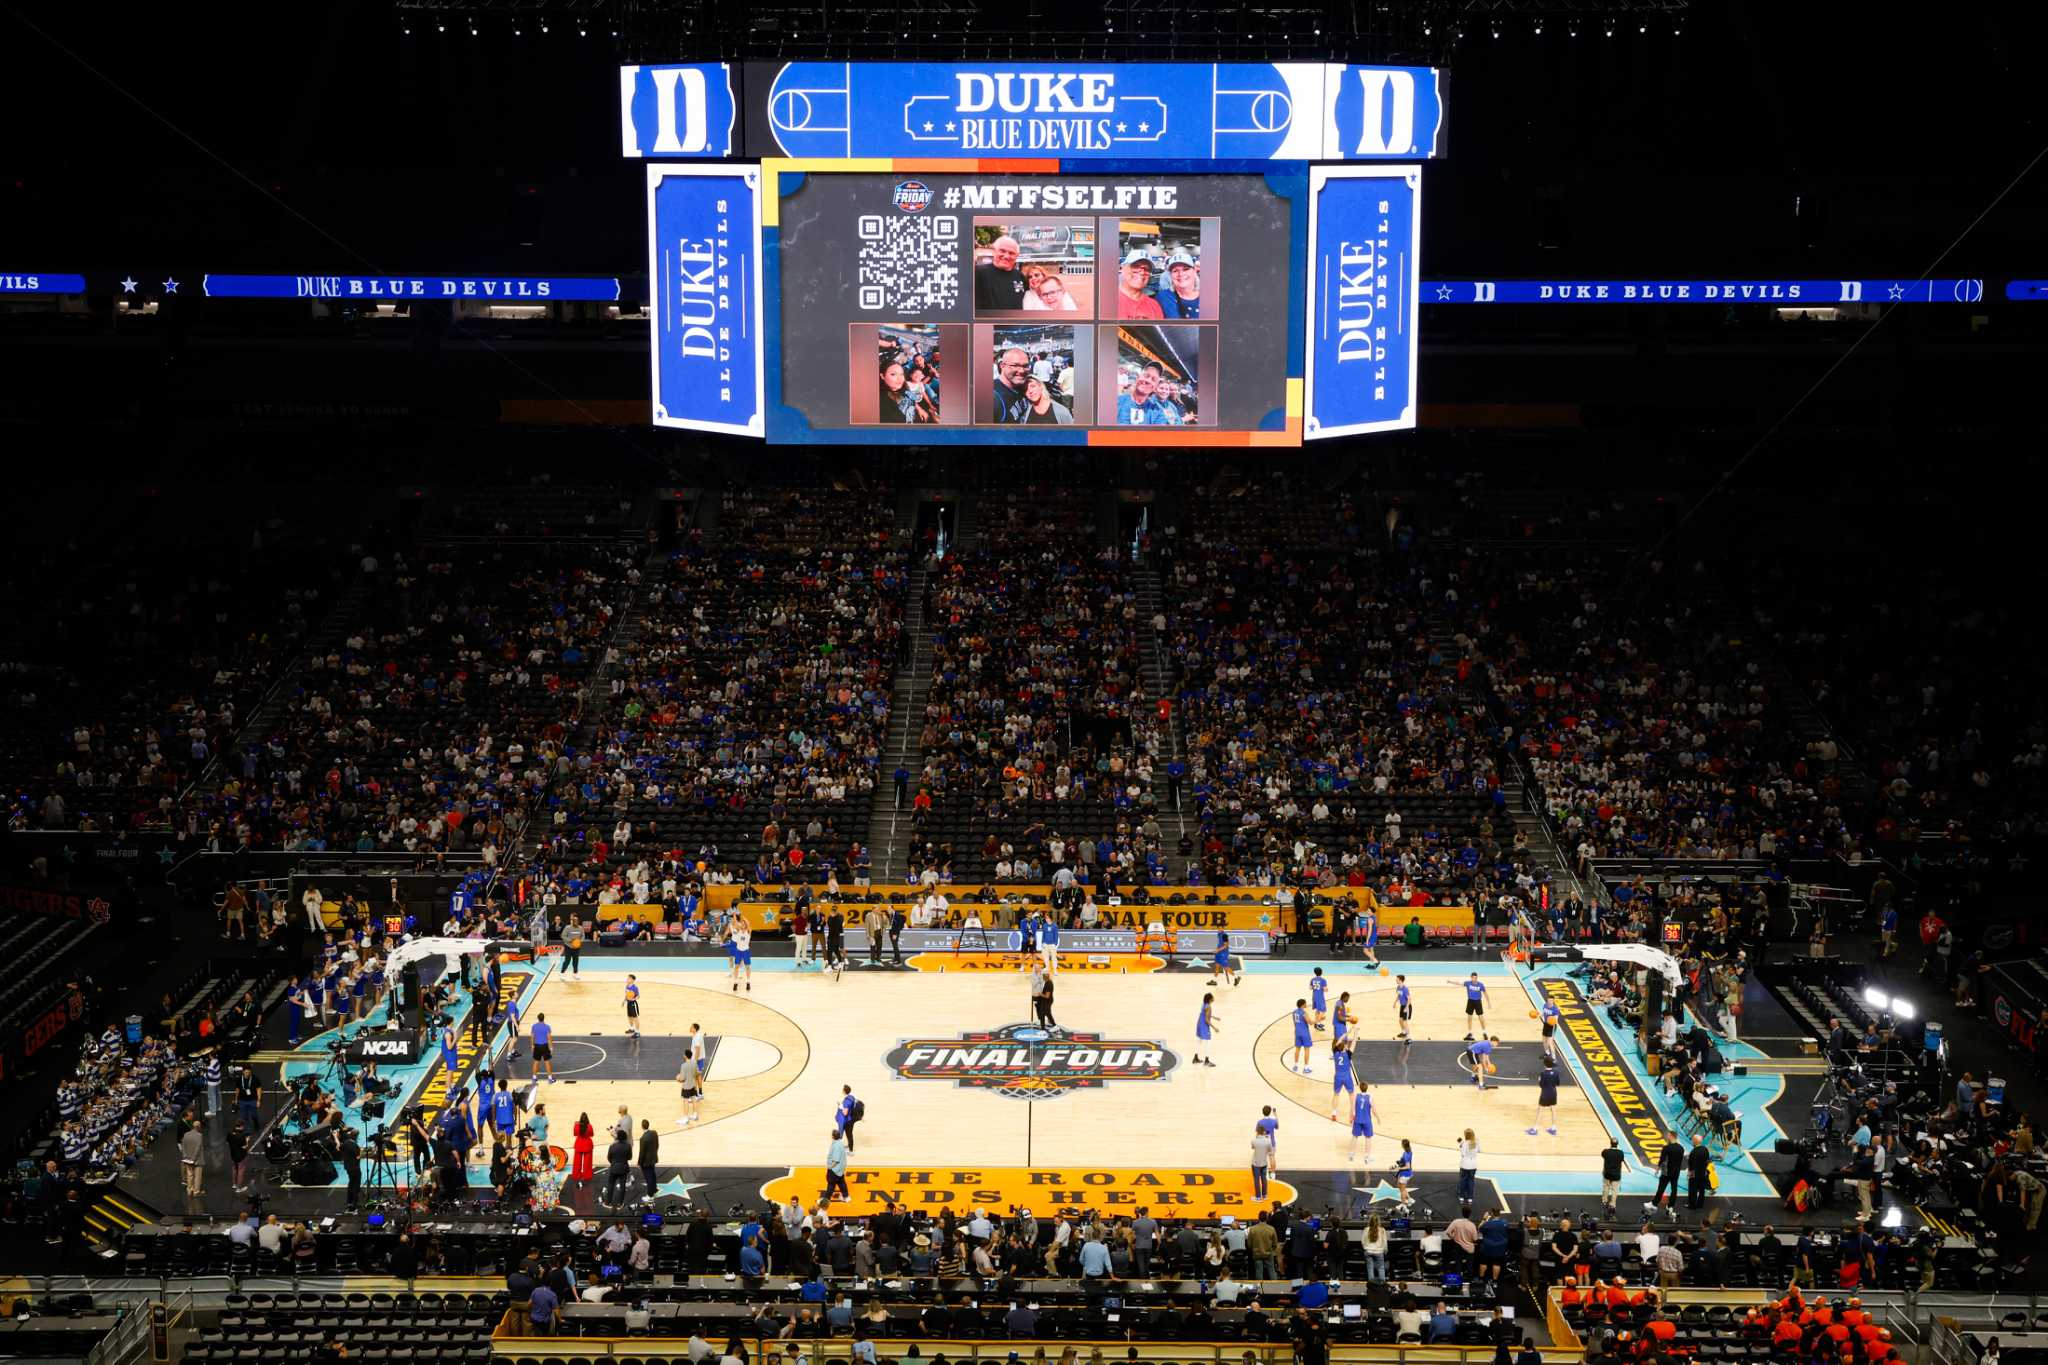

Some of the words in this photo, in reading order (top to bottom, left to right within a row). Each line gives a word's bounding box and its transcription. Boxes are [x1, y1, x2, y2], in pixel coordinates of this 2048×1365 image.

[956, 73, 1115, 112] DUKE
[651, 68, 707, 152] D
[1356, 70, 1414, 154] D
[961, 118, 1022, 149] BLUE
[1028, 119, 1111, 150] DEVILS
[895, 192, 931, 203] FRIDAY
[943, 185, 1178, 210] #MFFSELFIE
[717, 199, 729, 310] DEVILS
[1377, 200, 1389, 309] DEVILS
[297, 276, 341, 297] DUKE
[350, 280, 424, 295] BLUE
[442, 281, 551, 296] DEVILS
[680, 238, 716, 360] DUKE
[1540, 285, 1609, 298] DUKE
[1624, 285, 1690, 298] BLUE
[1705, 285, 1801, 298] DEVILS
[1338, 240, 1374, 364] DUKE
[719, 327, 731, 402] BLUE
[1375, 326, 1386, 400] BLUE
[1160, 911, 1229, 927] FOUR
[362, 1041, 409, 1056] NCAA
[903, 1049, 1032, 1066] FINAL
[1040, 1049, 1164, 1067] FOUR
[1338, 1056, 1344, 1065] 2
[1564, 1019, 1616, 1063] MEN'S
[1593, 1066, 1647, 1114] FINAL
[498, 1096, 507, 1107] 21
[846, 1171, 982, 1185] THE
[1028, 1172, 1215, 1186] ROAD
[1048, 1190, 1243, 1205] HERE
